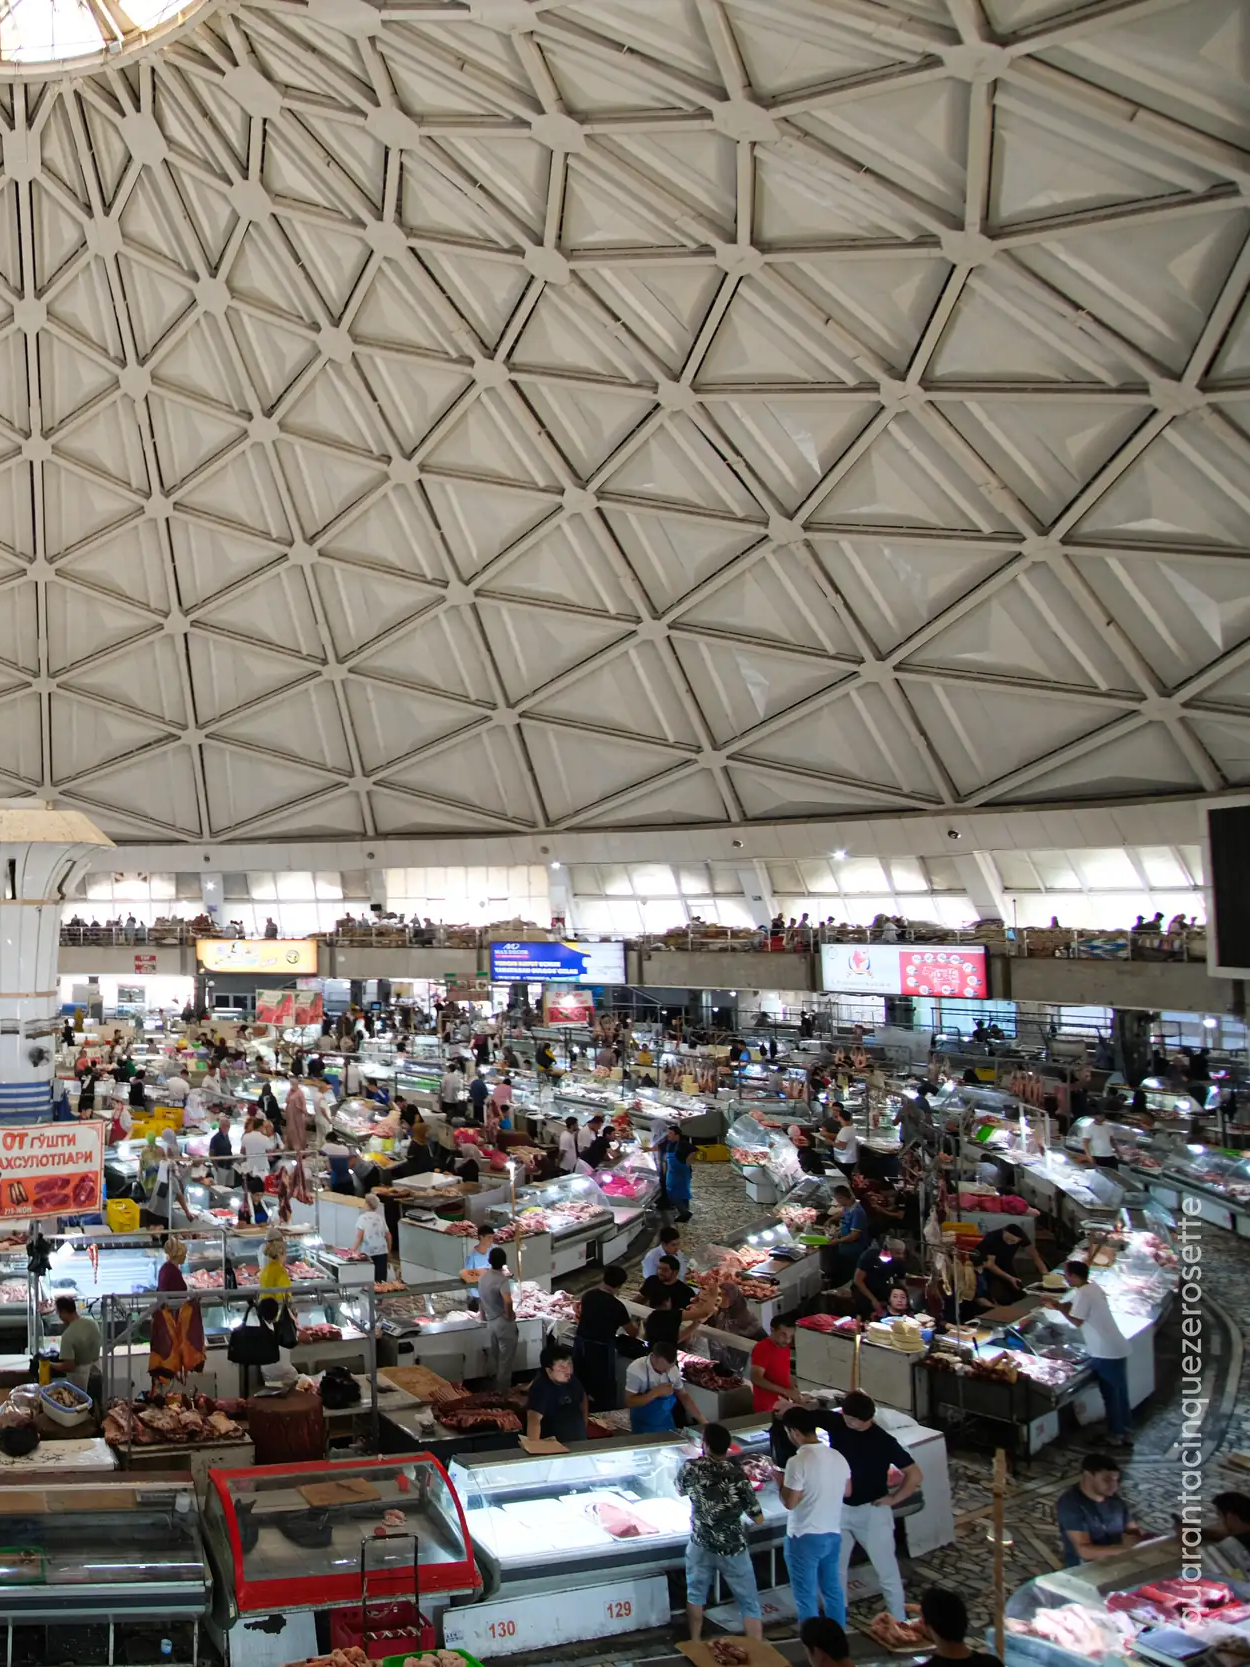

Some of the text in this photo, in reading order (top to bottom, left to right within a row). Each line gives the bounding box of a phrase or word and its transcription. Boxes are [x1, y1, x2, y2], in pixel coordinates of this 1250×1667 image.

[2, 1132, 76, 1151] ОТ ГЎШТИ
[607, 1601, 632, 1619] 129
[489, 1620, 516, 1639] 130
